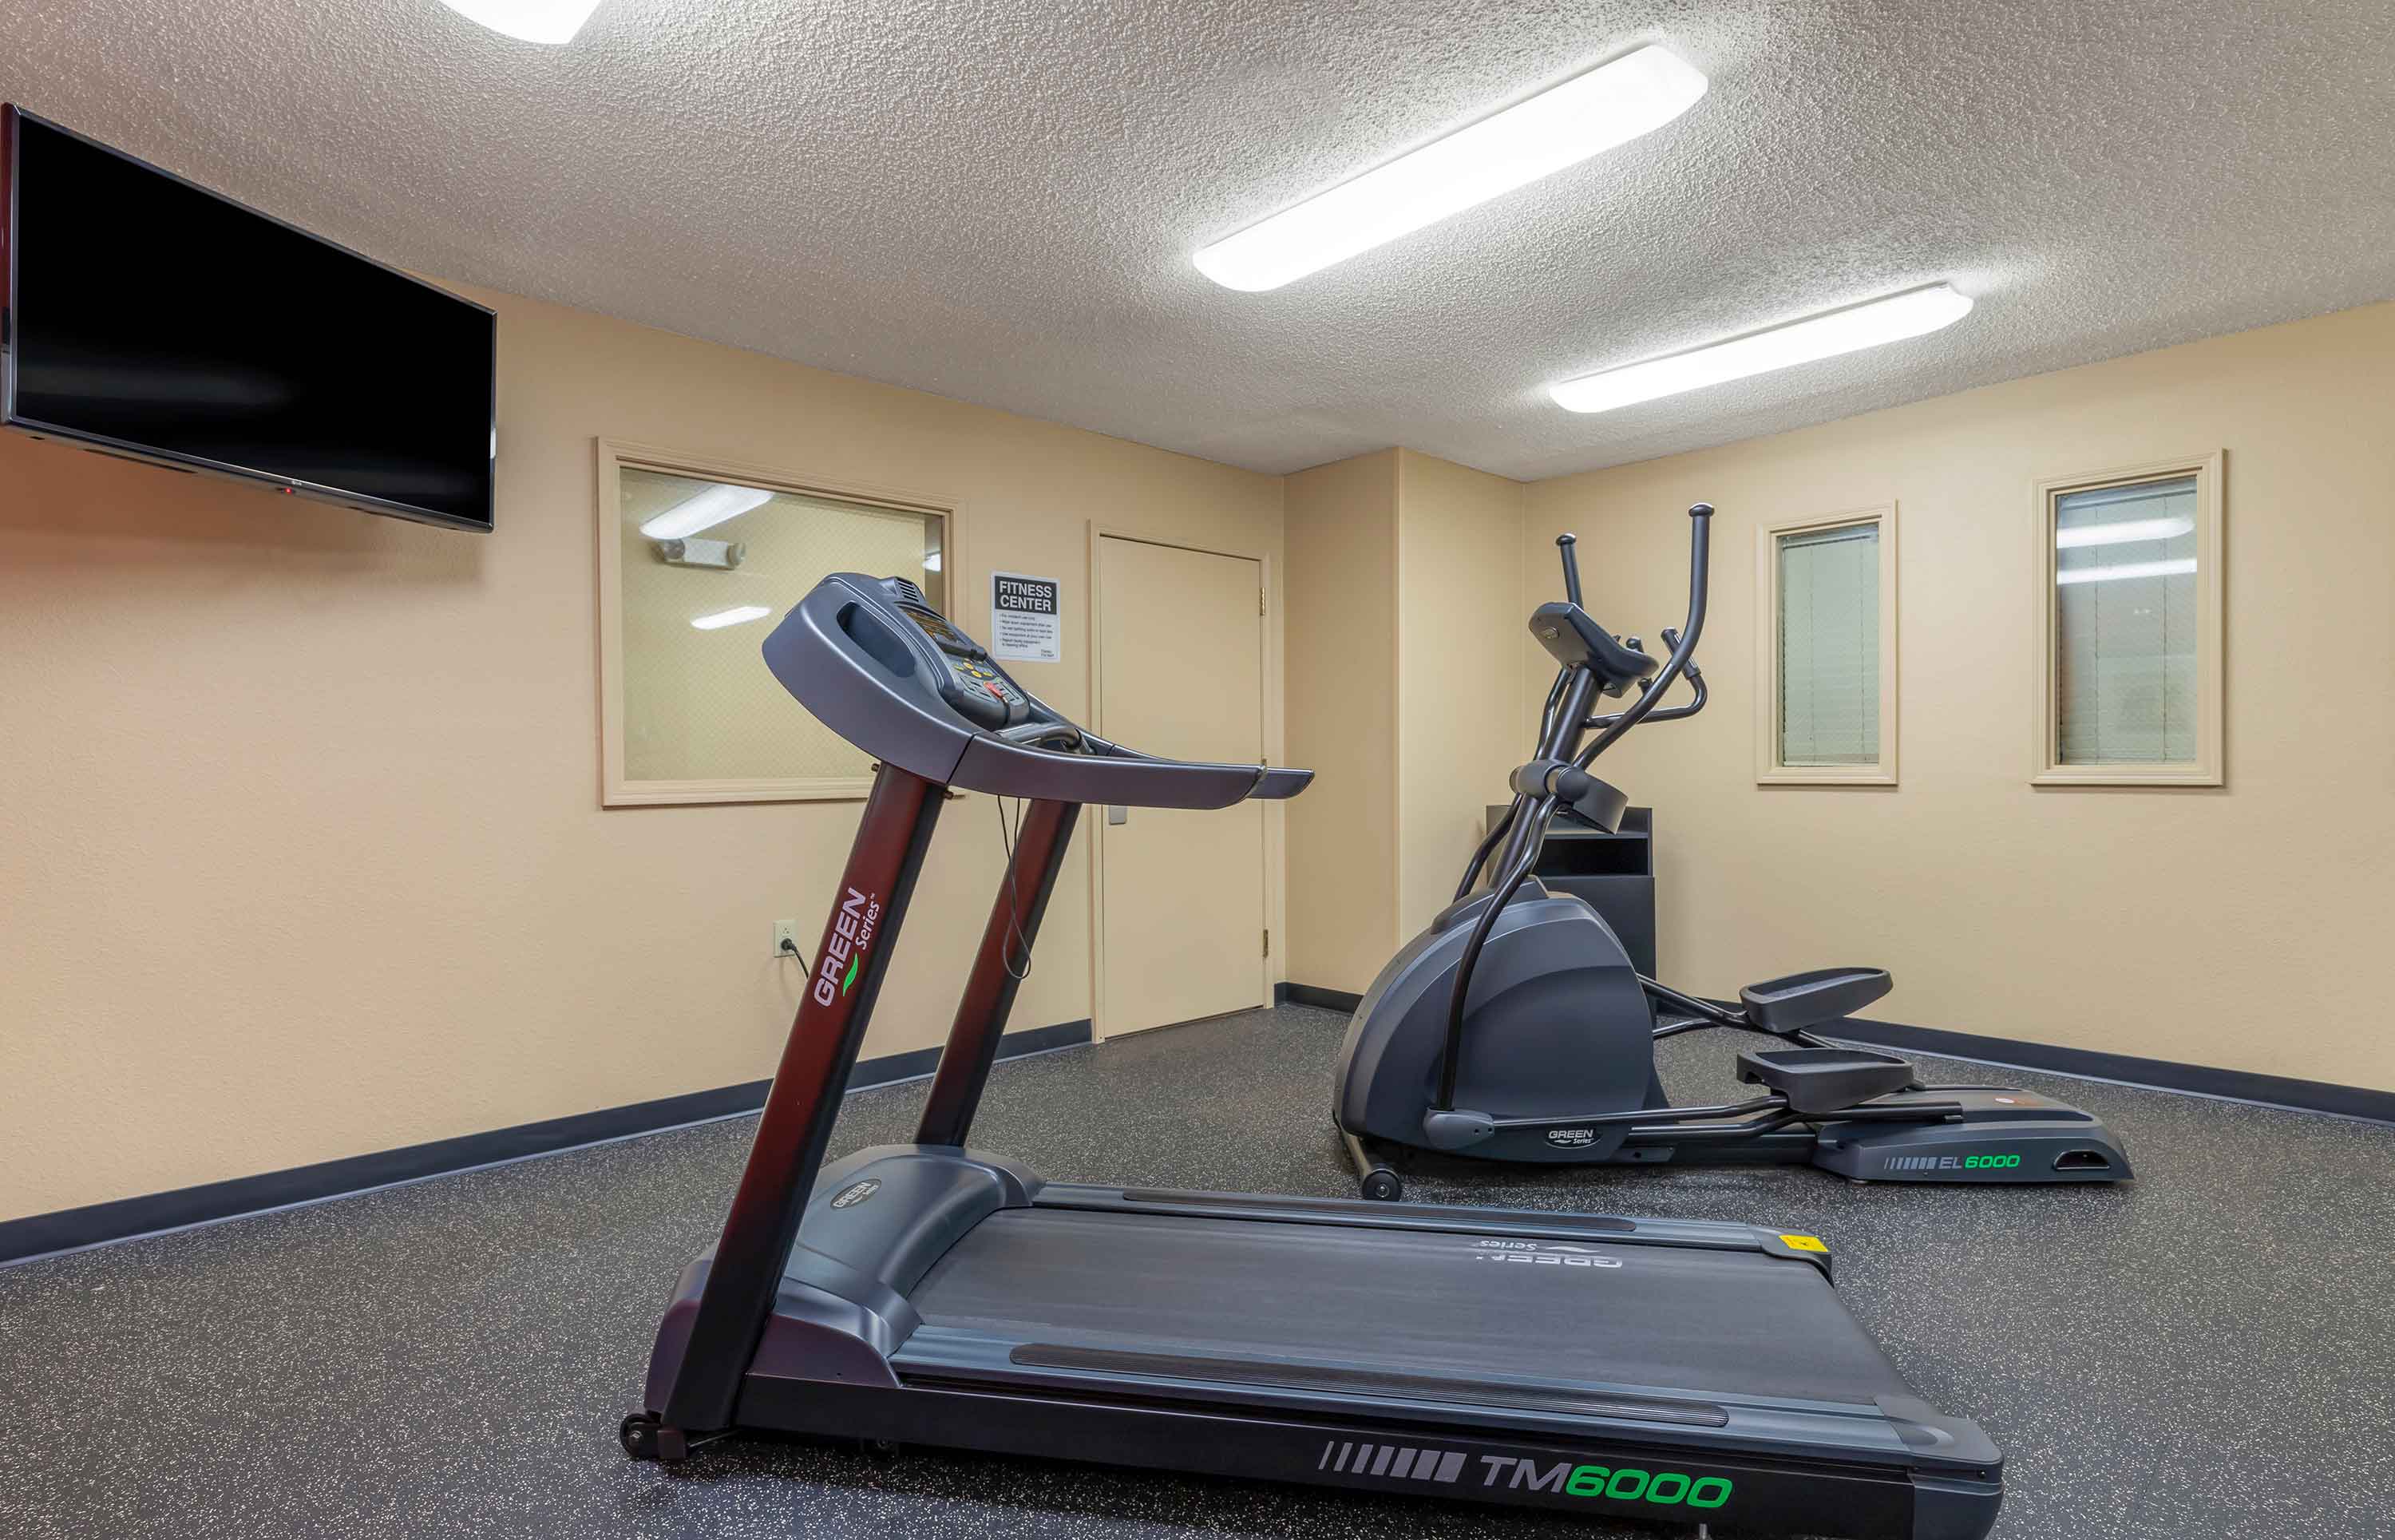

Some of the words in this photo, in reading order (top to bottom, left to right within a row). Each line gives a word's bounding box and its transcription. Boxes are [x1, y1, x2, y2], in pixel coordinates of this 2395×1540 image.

[1000, 580, 1052, 598] FITNESS
[1000, 595, 1051, 612] CENTER
[814, 887, 865, 1007] GREEN
[1549, 1129, 1593, 1138] GREEN
[1481, 1241, 1537, 1251] Series
[1480, 1455, 1733, 1508] TM6000
